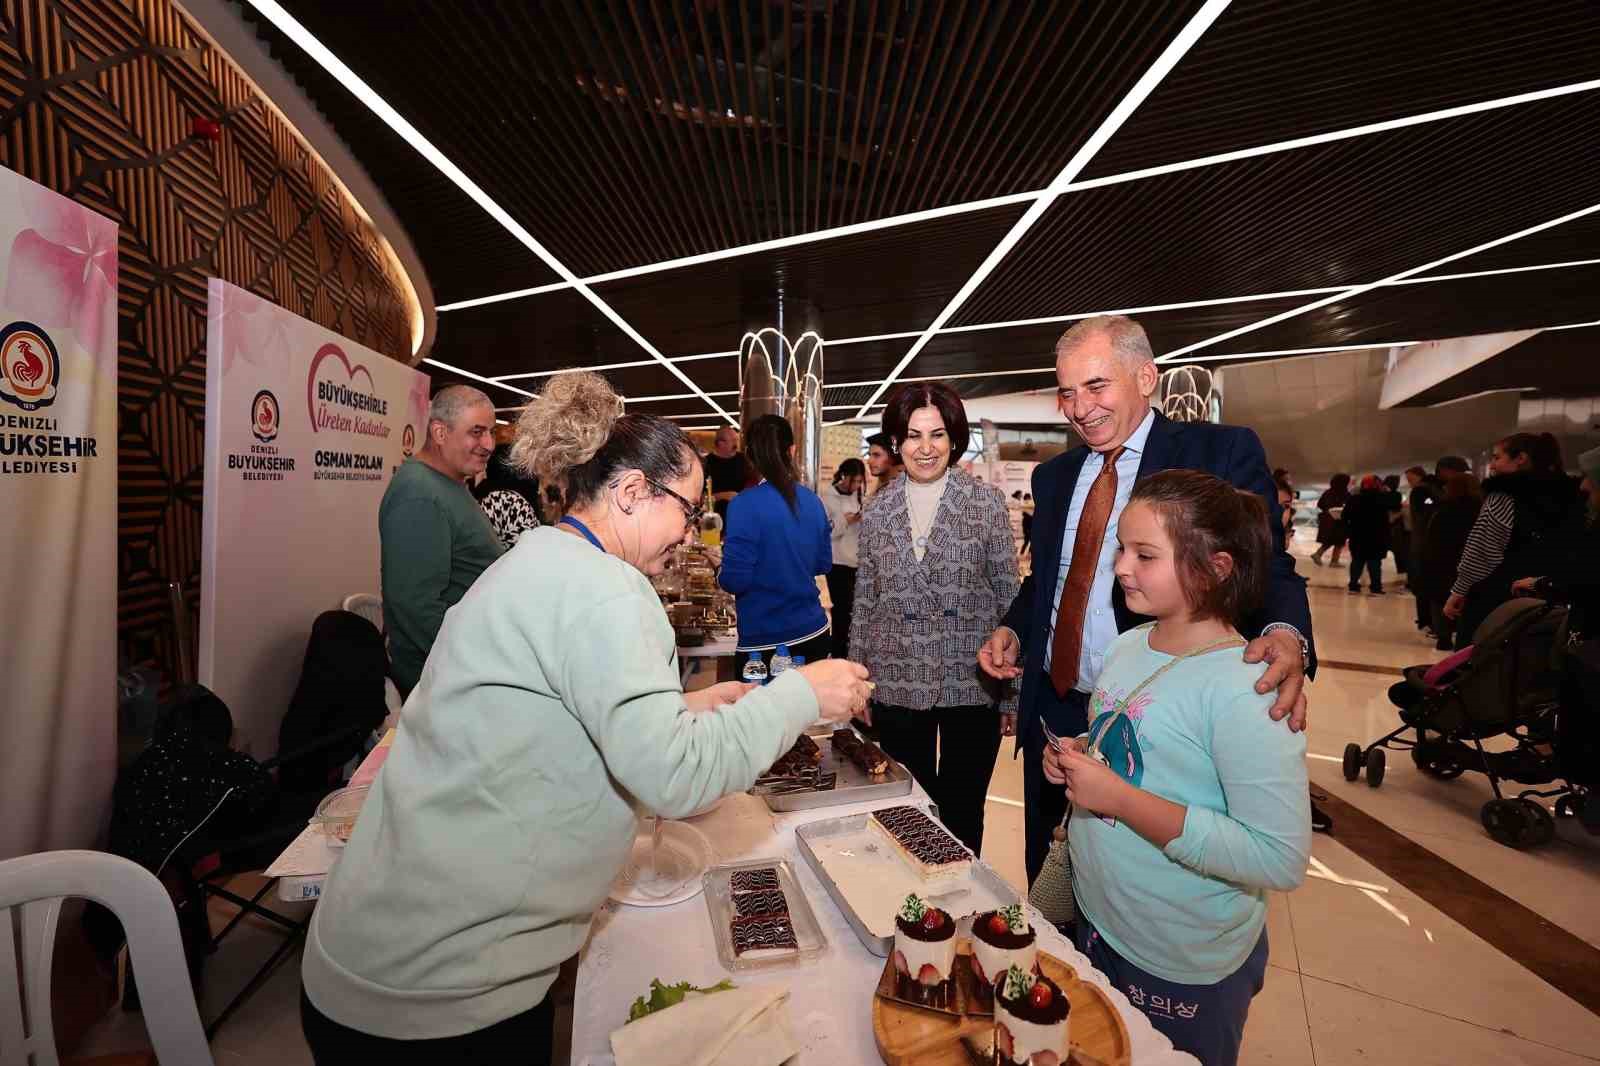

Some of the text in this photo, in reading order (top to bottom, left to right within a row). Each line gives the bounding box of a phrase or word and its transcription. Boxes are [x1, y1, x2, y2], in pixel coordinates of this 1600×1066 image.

[318, 380, 387, 416] BÜYÜKŞEHİRLE
[317, 403, 352, 432] Üreten
[315, 450, 352, 468] OSMAN
[354, 454, 383, 470] ZOLAN
